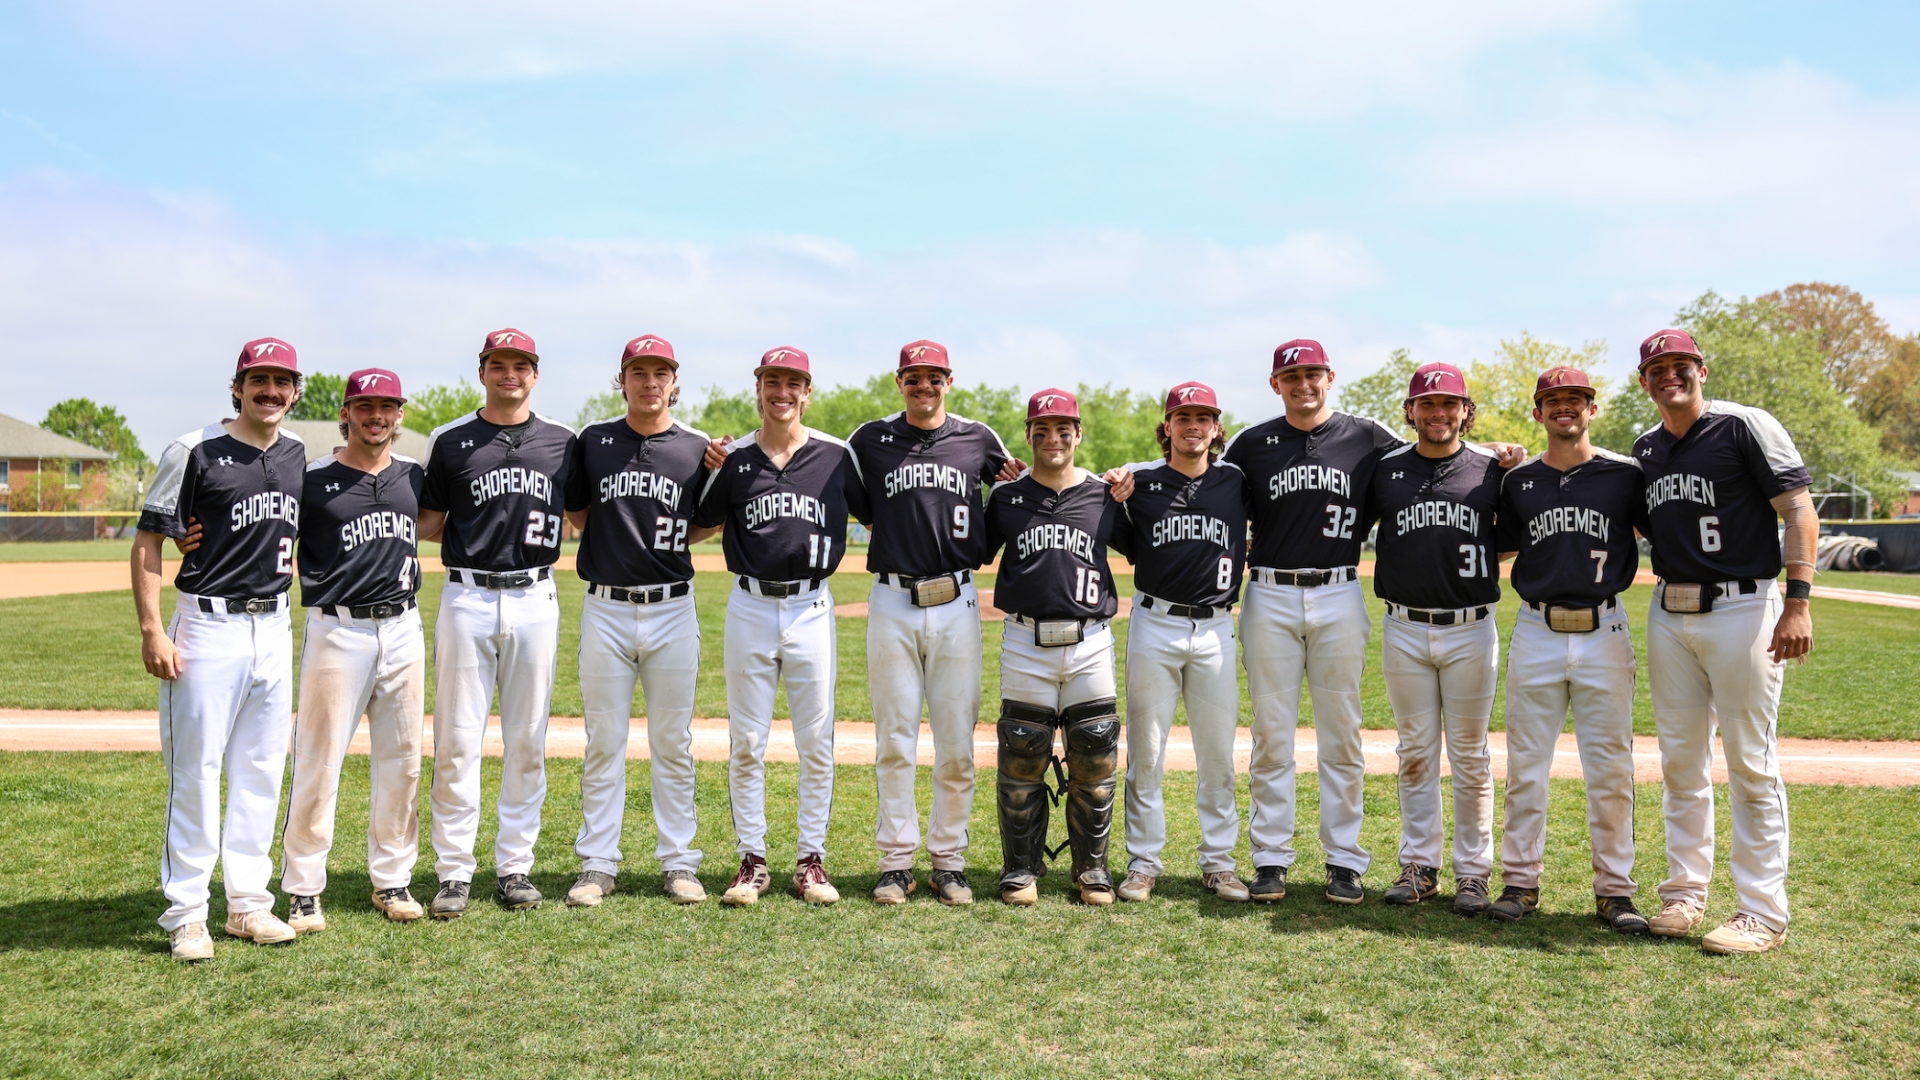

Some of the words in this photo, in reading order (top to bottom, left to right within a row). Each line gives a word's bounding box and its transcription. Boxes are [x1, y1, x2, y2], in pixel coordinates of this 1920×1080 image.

[470, 466, 553, 507] SHOREMEN
[599, 470, 683, 512] SHOREMEN
[884, 462, 967, 499] SHOREMEN
[1269, 464, 1351, 501] SHOREMEN
[1645, 472, 1716, 516] SHOREMEN
[230, 491, 300, 532] SHOREMEN
[524, 510, 561, 549] 23
[745, 491, 826, 532] SHOREMEN
[952, 504, 970, 539] 9
[1322, 504, 1357, 540] 32
[1396, 500, 1480, 537] SHOREMEN
[1528, 506, 1610, 546] SHOREMEN
[341, 511, 417, 552] SHOREMEN
[653, 516, 688, 552] 22
[1017, 523, 1096, 567] SHOREMEN
[1152, 514, 1229, 551] SHOREMEN
[1699, 515, 1722, 552] 6
[808, 533, 832, 570] 11
[1458, 544, 1488, 578] 31
[1590, 549, 1608, 583] 7
[1072, 566, 1101, 607] 16
[1216, 557, 1233, 590] 8
